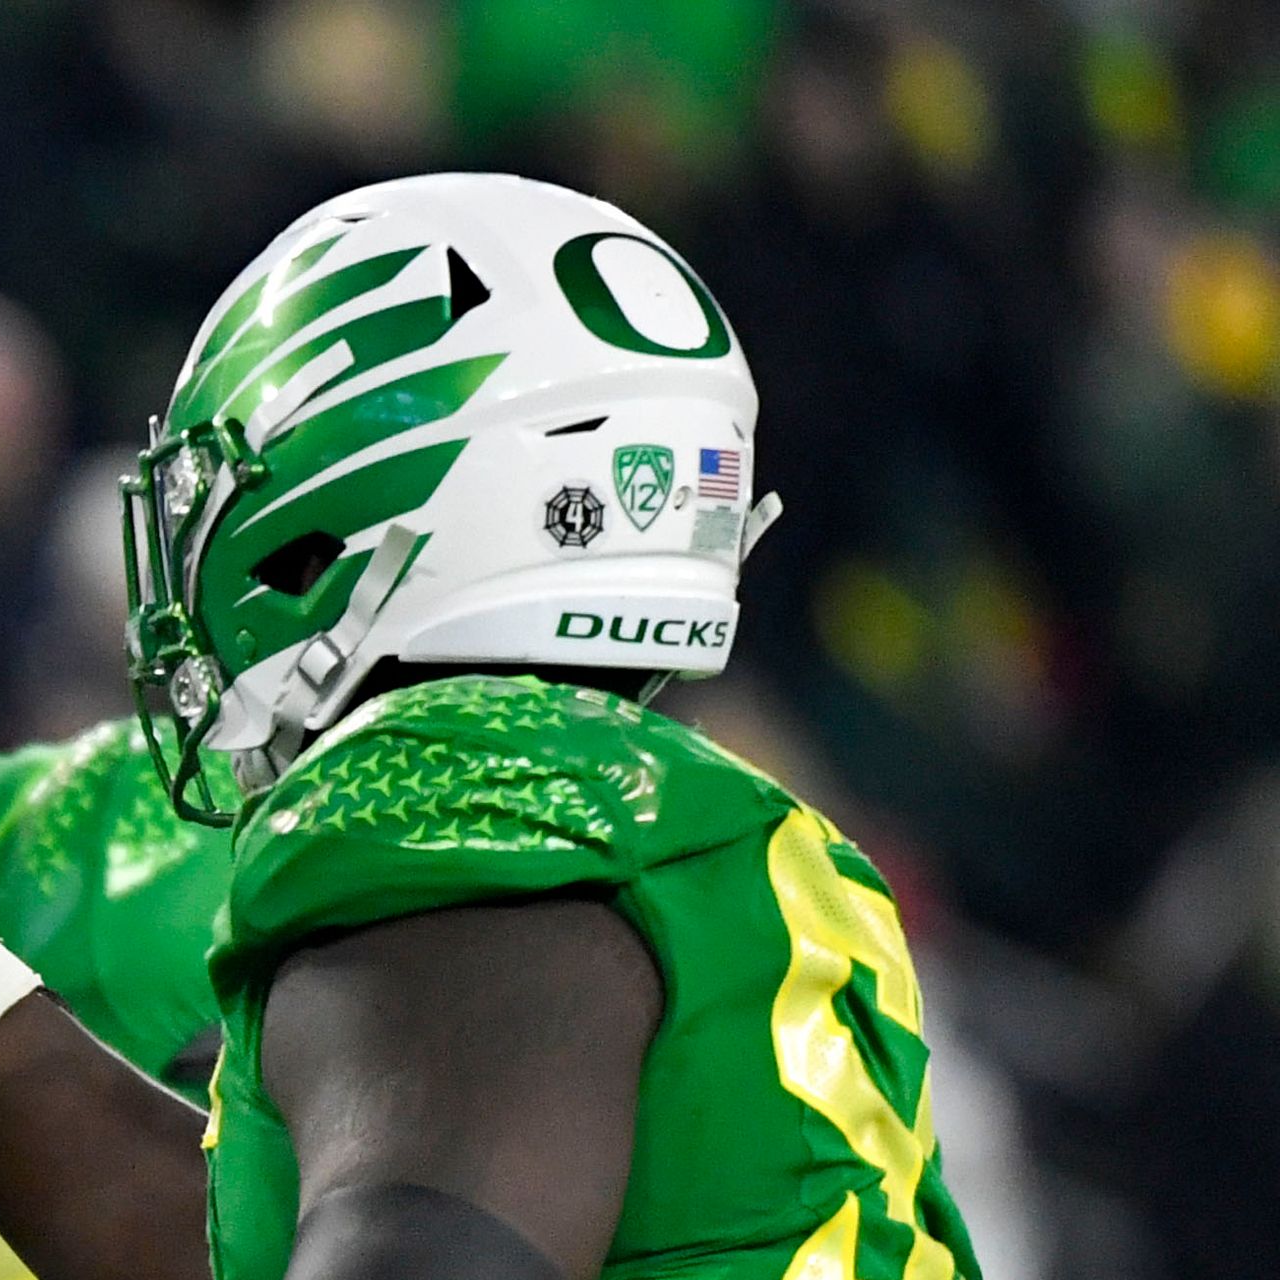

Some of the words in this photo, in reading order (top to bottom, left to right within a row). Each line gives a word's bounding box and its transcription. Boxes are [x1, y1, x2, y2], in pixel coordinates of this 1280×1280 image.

[552, 231, 731, 359] O
[616, 448, 670, 496] PAC
[630, 483, 658, 511] 12
[555, 612, 729, 648] DUCKS
